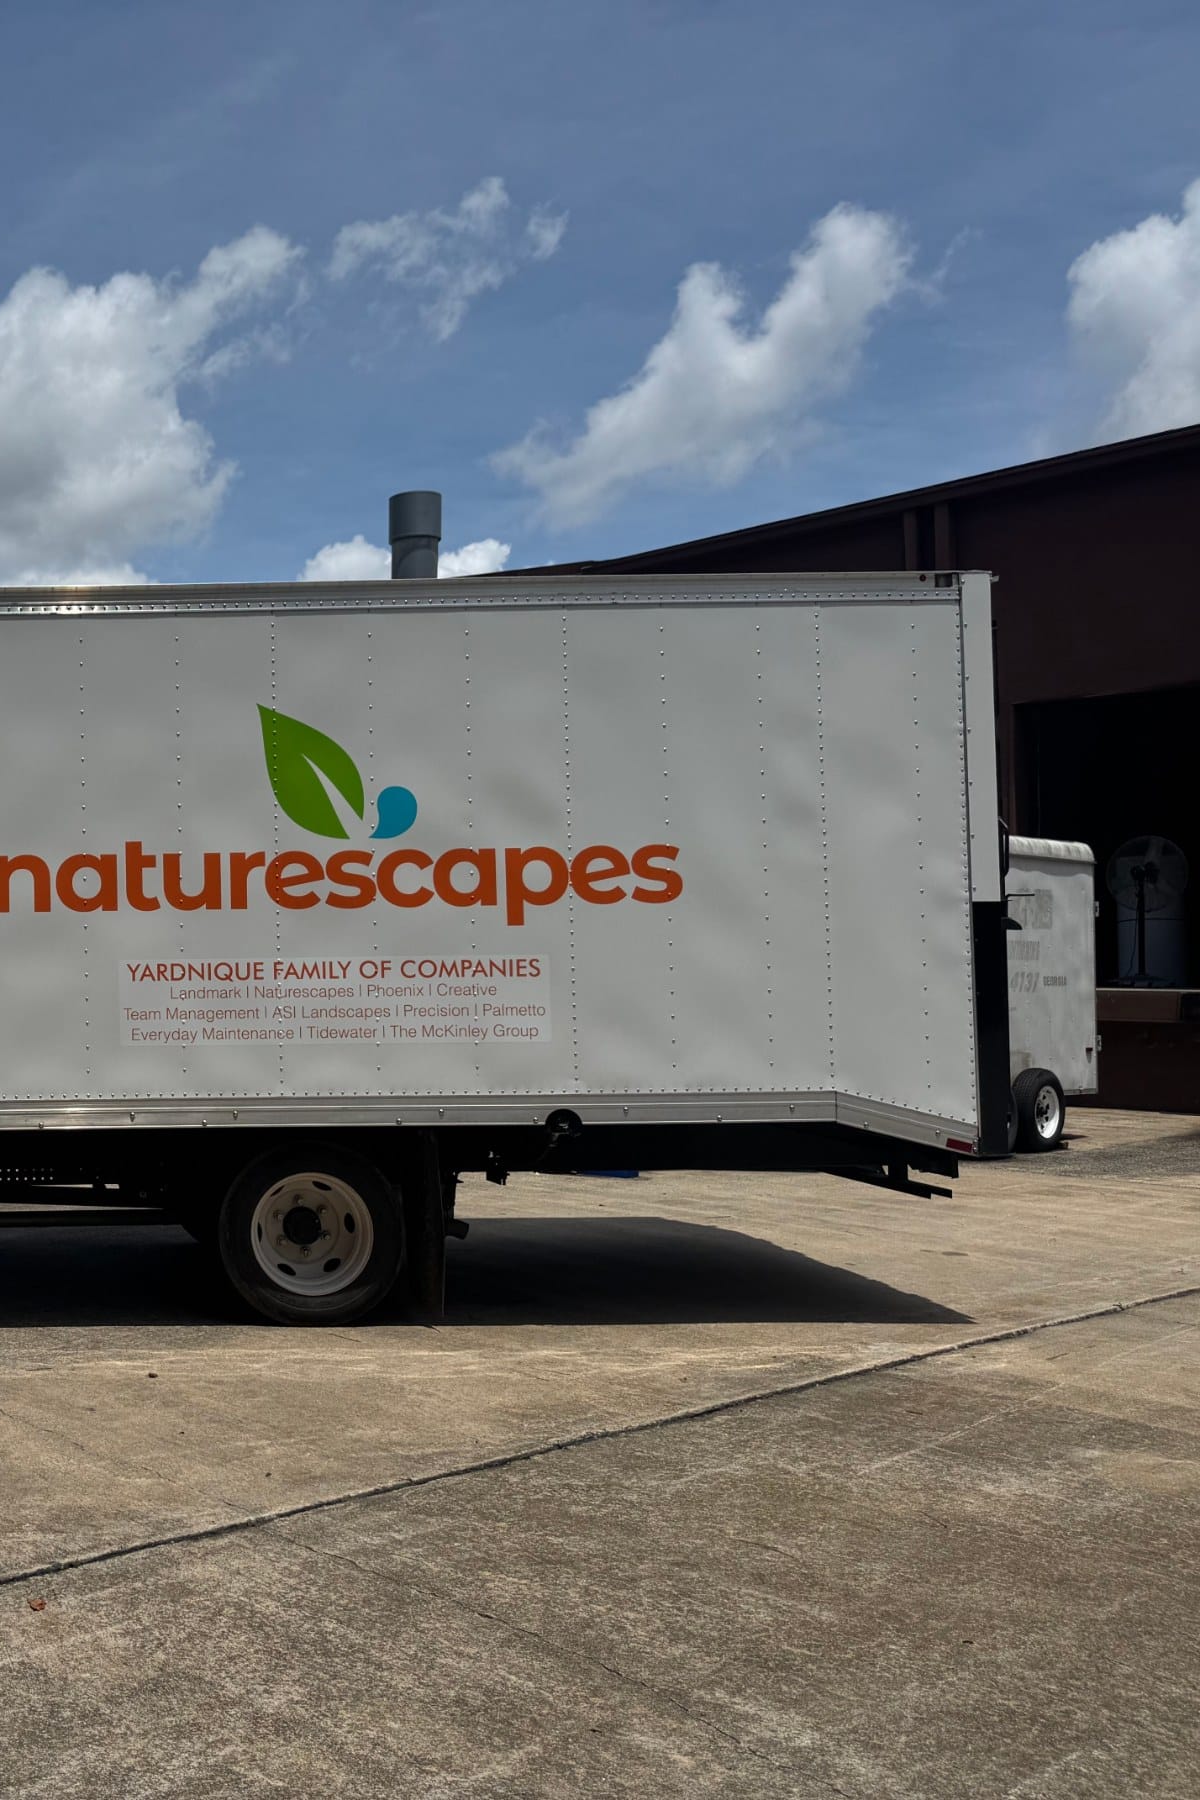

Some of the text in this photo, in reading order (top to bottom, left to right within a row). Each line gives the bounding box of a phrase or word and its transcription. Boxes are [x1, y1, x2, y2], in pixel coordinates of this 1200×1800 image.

[127, 959, 541, 982] YARDNIQUE FAMILY OF COMPANIES
[170, 986, 241, 1000] Landmark
[254, 984, 354, 1001] Naturescapes
[367, 984, 424, 997] Phoenix
[436, 983, 497, 997] Creative
[123, 1007, 160, 1021] Team
[166, 1007, 259, 1022] Management
[272, 1005, 296, 1019] ASI
[302, 1005, 391, 1020] Landscapes
[403, 1004, 469, 1017] Precision
[483, 1003, 546, 1017] Palmetto
[131, 1028, 198, 1044] Everyday
[202, 1027, 294, 1040] Maintenance
[307, 1026, 377, 1039] Tidewater
[390, 1025, 417, 1038] The
[422, 1024, 489, 1040] McKinley
[493, 1024, 539, 1040] Group
